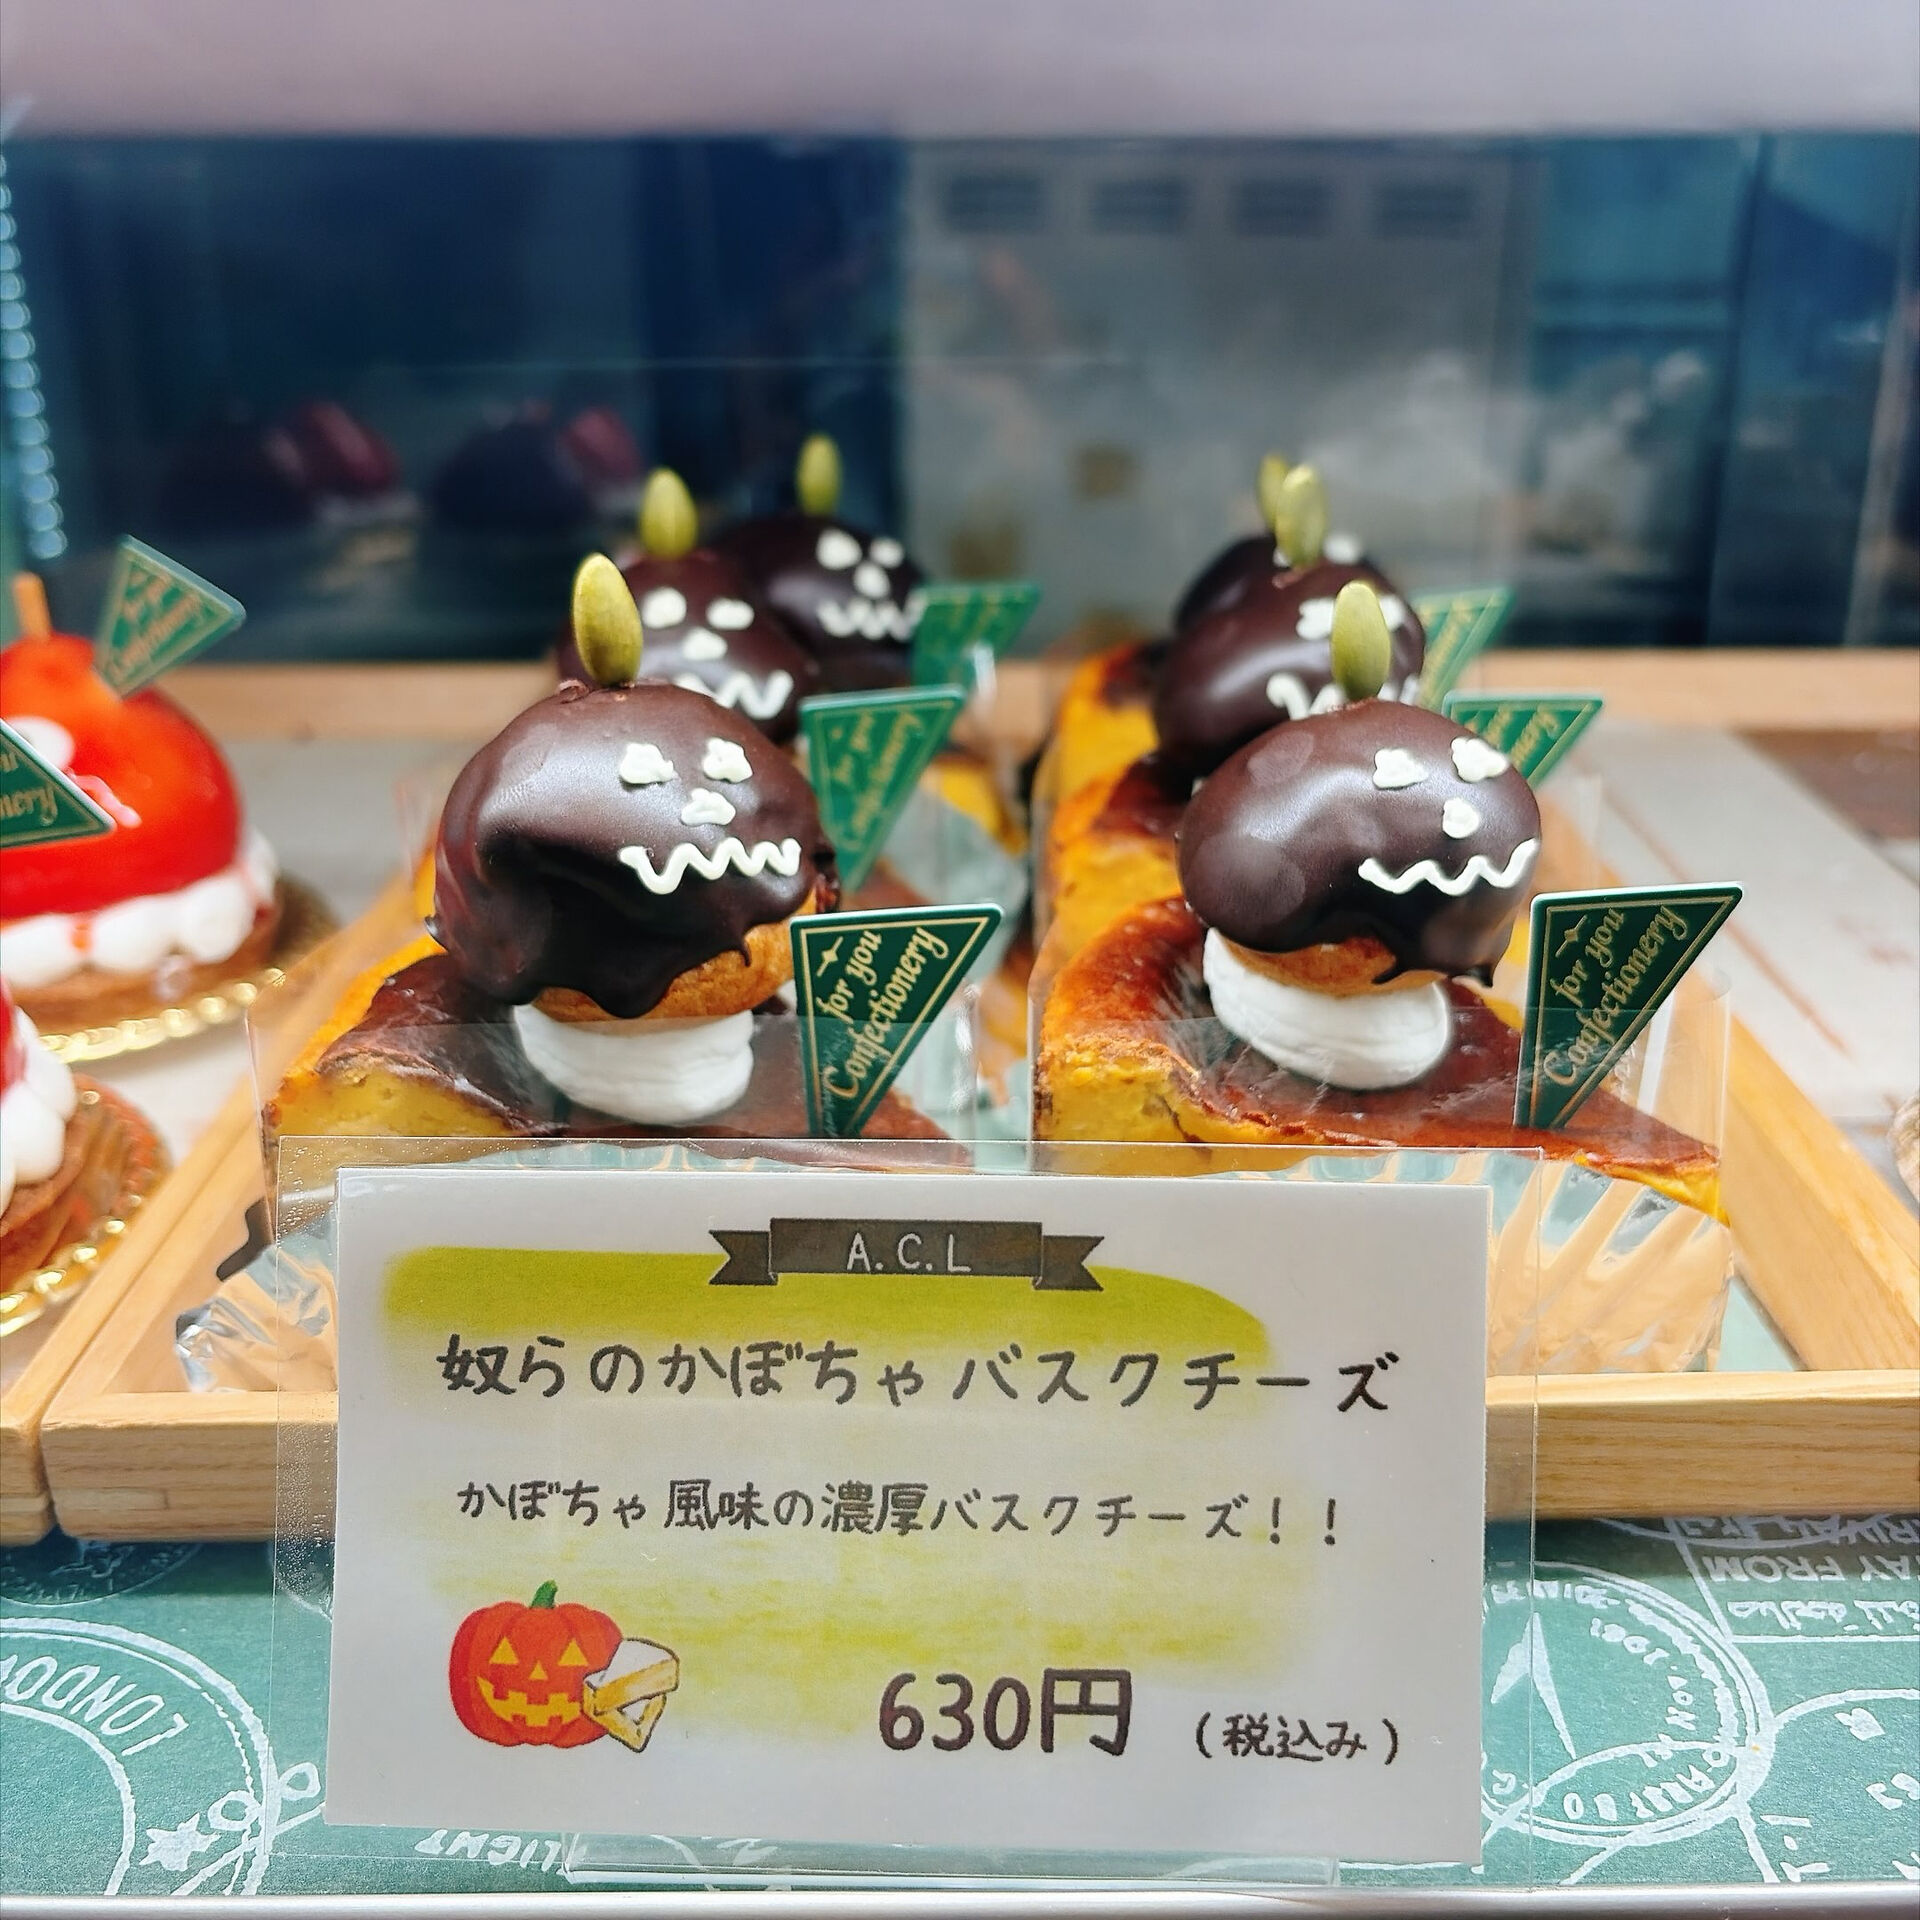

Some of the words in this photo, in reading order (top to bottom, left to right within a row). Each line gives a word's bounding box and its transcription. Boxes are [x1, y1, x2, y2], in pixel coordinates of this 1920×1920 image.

[816, 978, 854, 1024] for
[845, 930, 882, 986] you
[1543, 905, 1688, 1086] Confectionery
[1550, 959, 1588, 1008] for
[1585, 907, 1624, 968] you
[822, 926, 949, 1098] Confectionery
[847, 1232, 972, 1272] A.C.L
[436, 1334, 1400, 1412] 奴らのかぼちゃバスクチーズ
[1702, 1555, 1846, 1583] FROM
[1859, 1555, 1920, 1582] AY
[880, 1668, 1133, 1757] 630円
